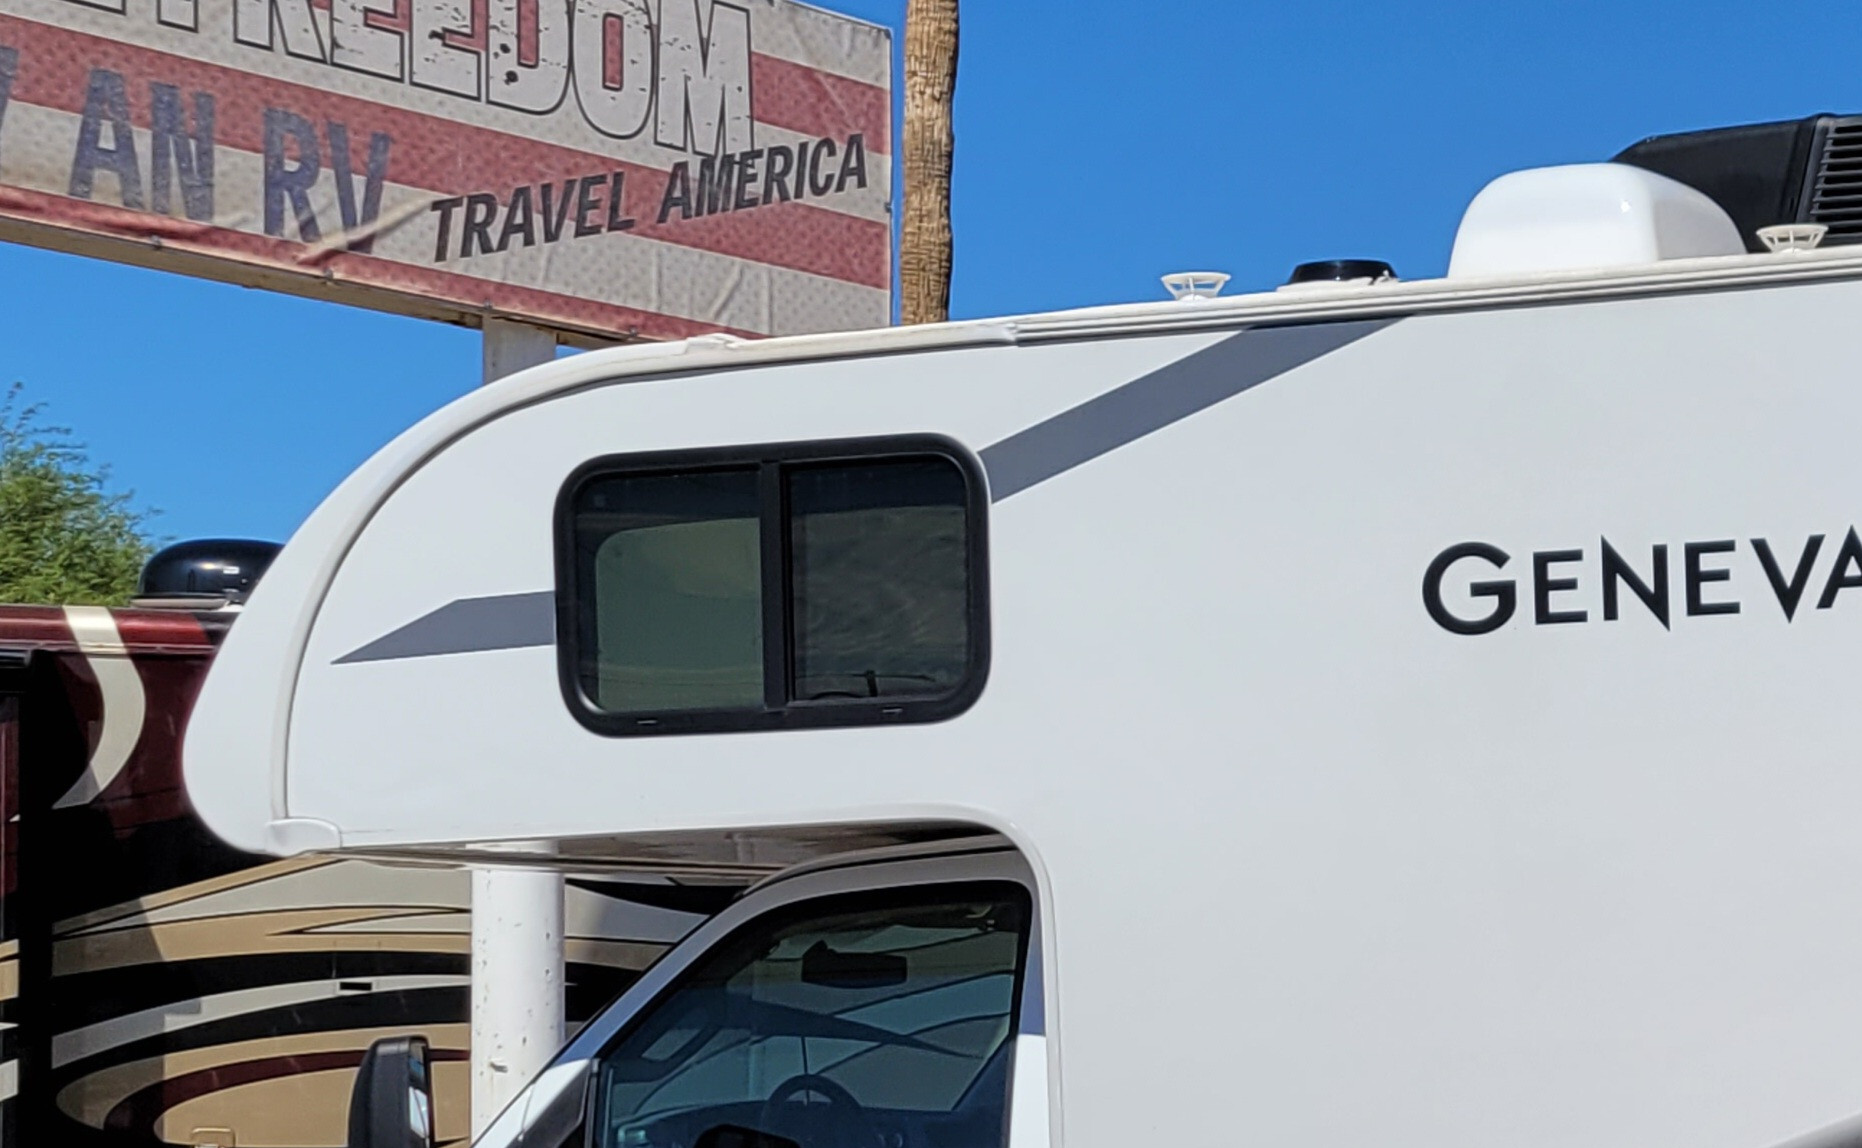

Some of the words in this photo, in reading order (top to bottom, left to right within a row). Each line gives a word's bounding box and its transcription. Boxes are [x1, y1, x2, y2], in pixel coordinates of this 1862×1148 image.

[157, 0, 755, 160] EEDOM
[69, 68, 215, 222] AN
[263, 107, 393, 254] RV
[430, 171, 635, 263] TRAVEL
[657, 133, 868, 224] AMERICA
